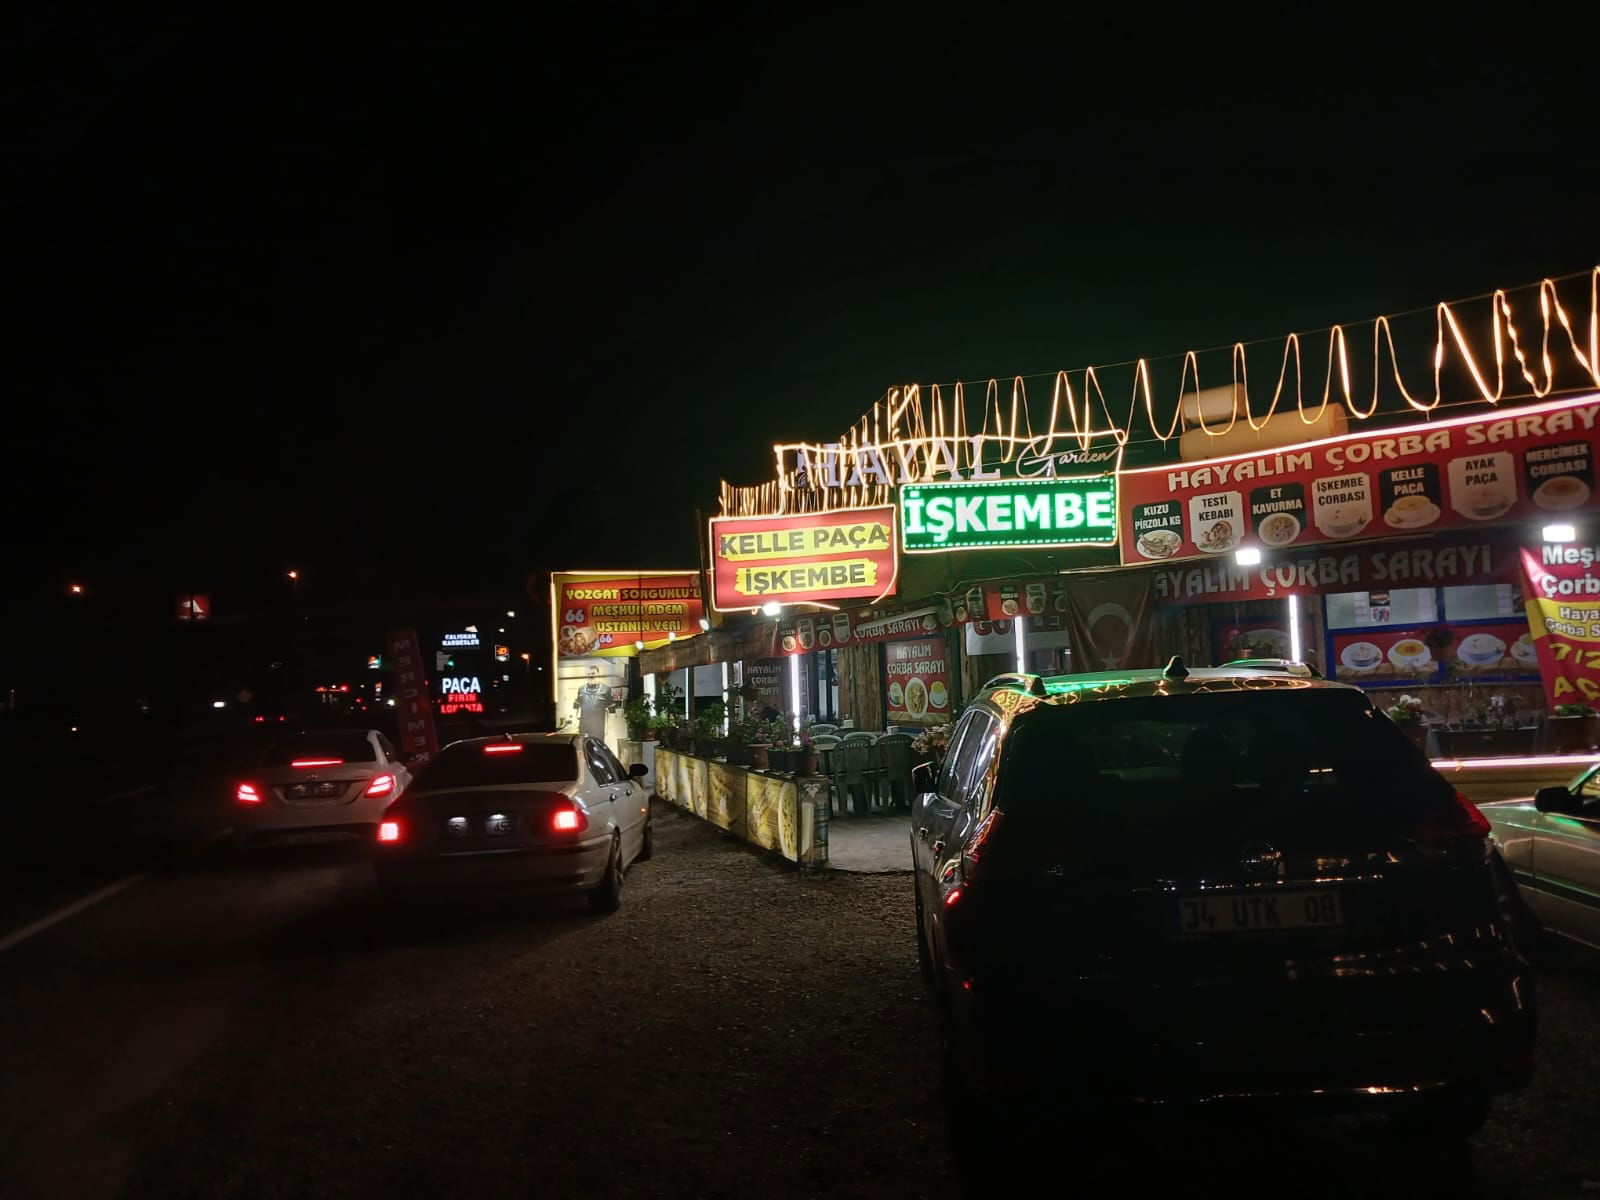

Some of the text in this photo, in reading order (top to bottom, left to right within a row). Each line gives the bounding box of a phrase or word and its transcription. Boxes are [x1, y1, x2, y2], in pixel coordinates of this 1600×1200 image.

[1016, 435, 1121, 478] Garden
[1168, 451, 1313, 492] HAYALİM
[1325, 430, 1451, 471] ÇORBA
[1465, 457, 1496, 471] AYAK
[1391, 467, 1425, 482] KELLE
[1466, 472, 1498, 486] PAÇA
[1317, 477, 1365, 493] İŞKEMBE
[1394, 482, 1425, 497] PAÇA
[1202, 494, 1228, 508] TESTİ
[1270, 488, 1283, 499] ET
[1318, 491, 1365, 506] ÇORBASI
[1143, 504, 1169, 517] KUZU
[1252, 499, 1303, 515] KAVURMA
[904, 490, 1112, 543] İŞKEMBE
[1134, 515, 1181, 531] PİRZOLA KG
[1198, 509, 1234, 522] KEBABI
[720, 524, 888, 556] KELLE PAÇA
[1259, 553, 1361, 596] ÇORBA
[1371, 544, 1494, 582] SARAYI
[745, 563, 866, 595] İŞKEMBE
[566, 589, 619, 600] YOZGAT
[565, 608, 585, 623] 66
[592, 603, 683, 618] MEŞHUR ADEM
[596, 620, 650, 633] USTANIN
[887, 618, 920, 635] SARAYI
[1545, 618, 1585, 637] Çorba
[887, 660, 945, 678] ÇORBA SARAYI
